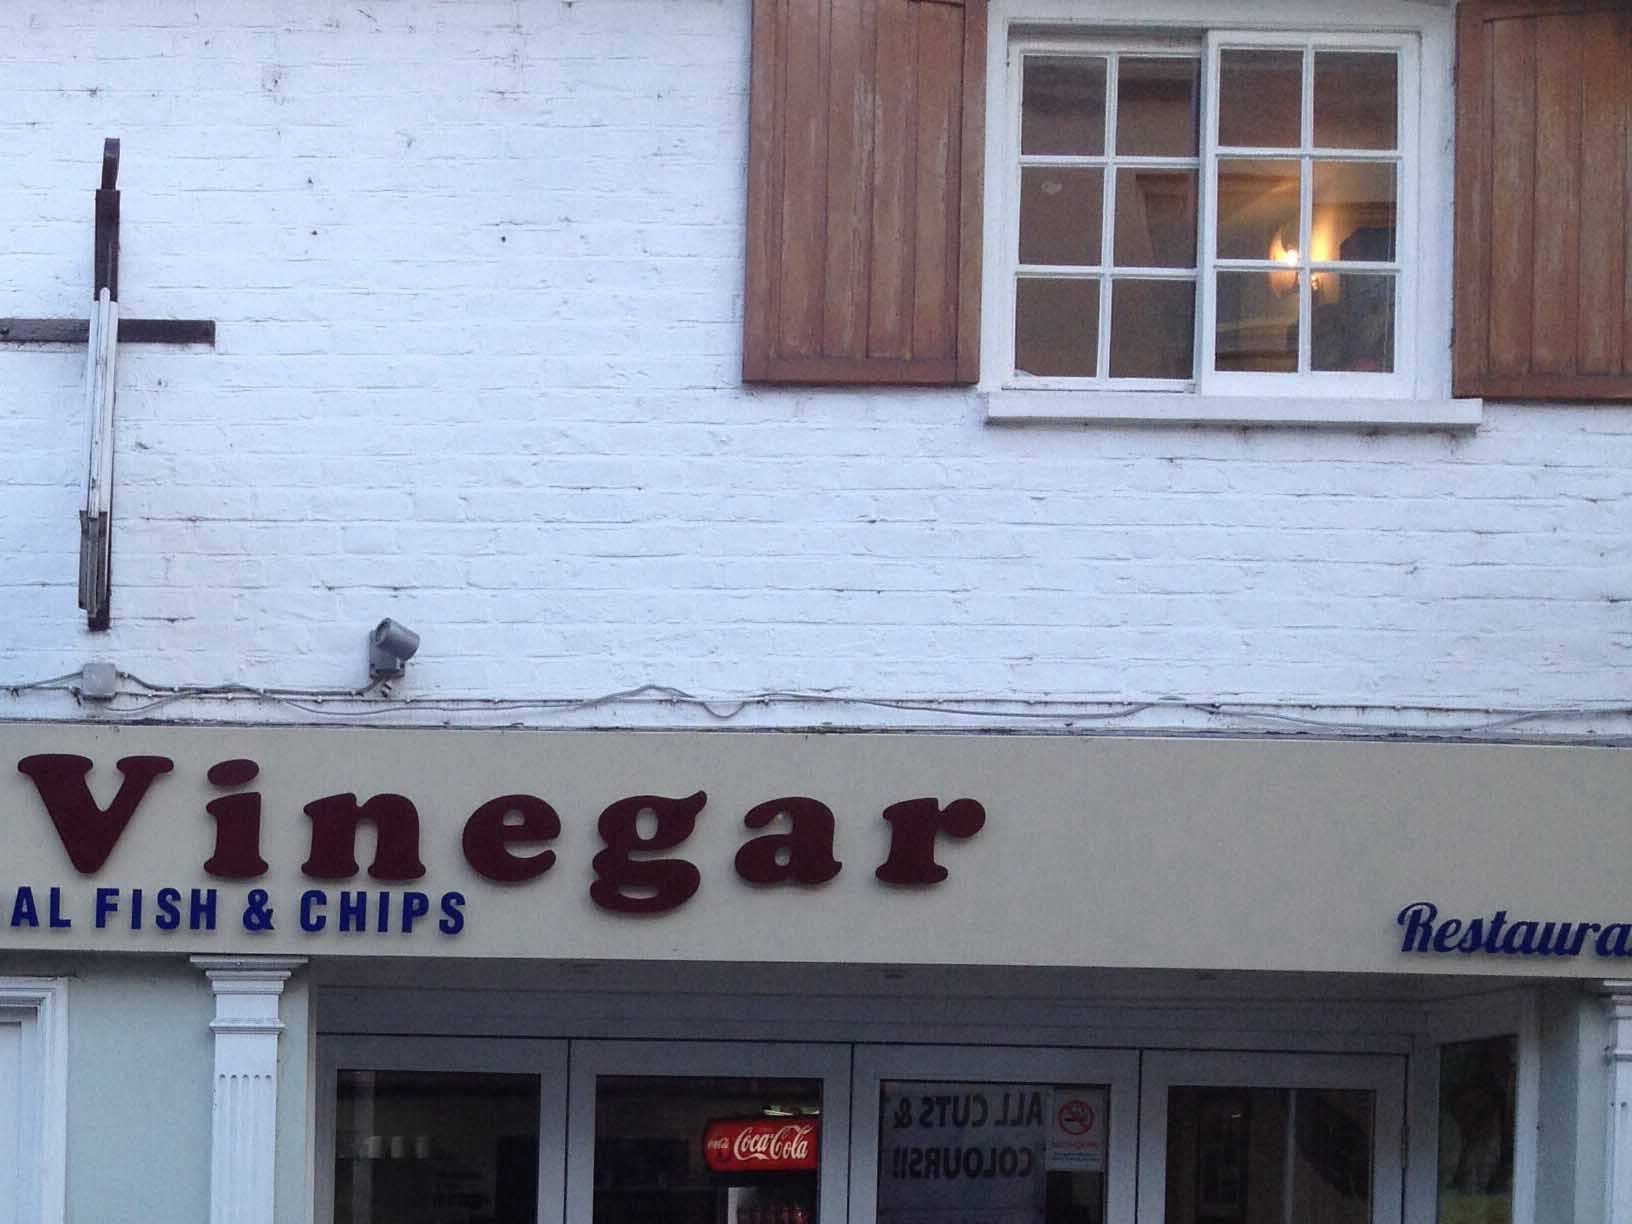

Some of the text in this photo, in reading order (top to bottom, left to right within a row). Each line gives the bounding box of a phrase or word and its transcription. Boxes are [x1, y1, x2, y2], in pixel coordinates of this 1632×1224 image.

[18, 754, 986, 913] Vinegar
[96, 887, 217, 931] FISH
[243, 889, 274, 931] &
[300, 890, 466, 935] CHIPS
